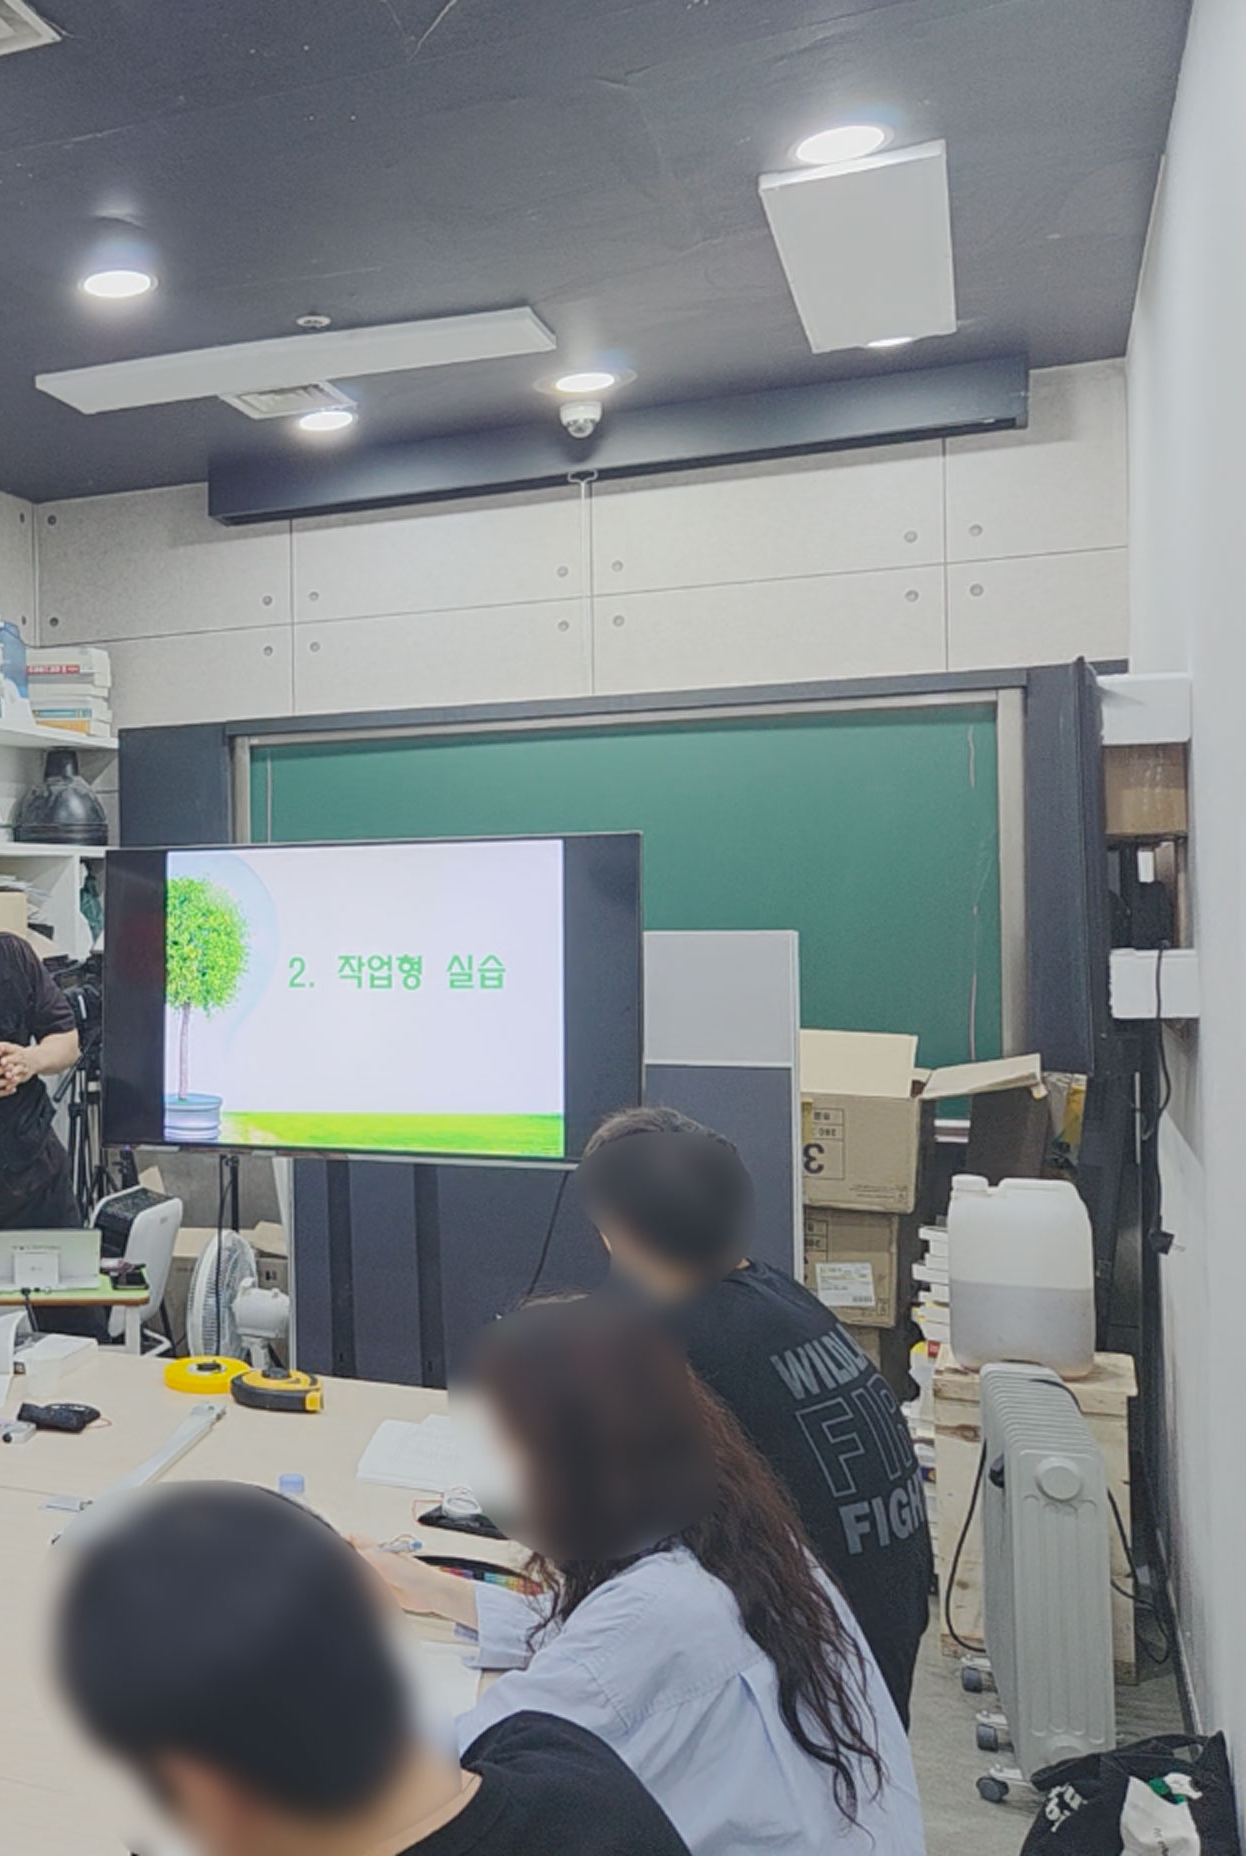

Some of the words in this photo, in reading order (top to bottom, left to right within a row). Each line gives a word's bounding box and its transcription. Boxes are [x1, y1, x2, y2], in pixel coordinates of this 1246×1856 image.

[288, 957, 315, 989] 2.
[337, 954, 424, 991] 작업형
[446, 953, 507, 991] 실습
